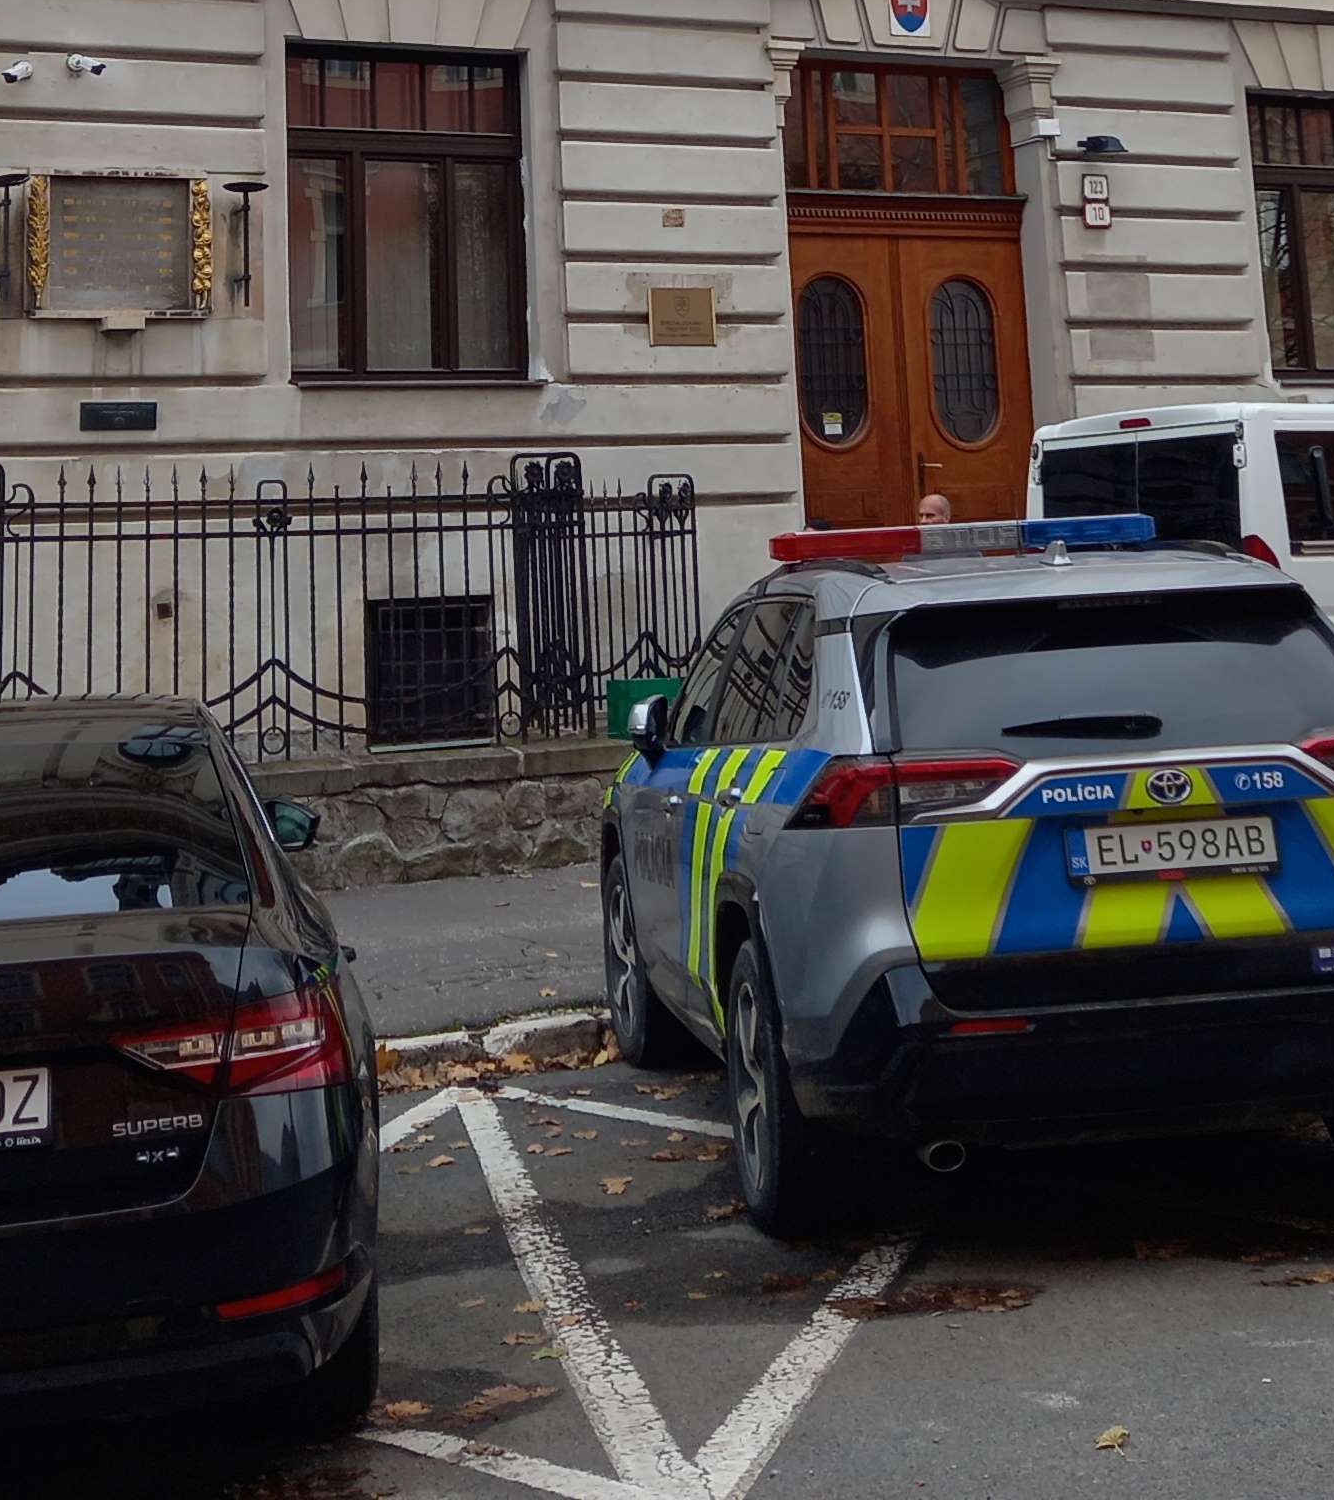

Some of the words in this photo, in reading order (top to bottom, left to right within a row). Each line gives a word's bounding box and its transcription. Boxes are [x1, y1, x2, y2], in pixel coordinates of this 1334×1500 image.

[1089, 180, 1104, 194] 123
[1092, 206, 1104, 221] 10
[1251, 771, 1284, 790] 158
[1042, 783, 1116, 804] POLÍCIA
[1071, 857, 1087, 869] SK
[112, 1113, 203, 1137] SUPERB
